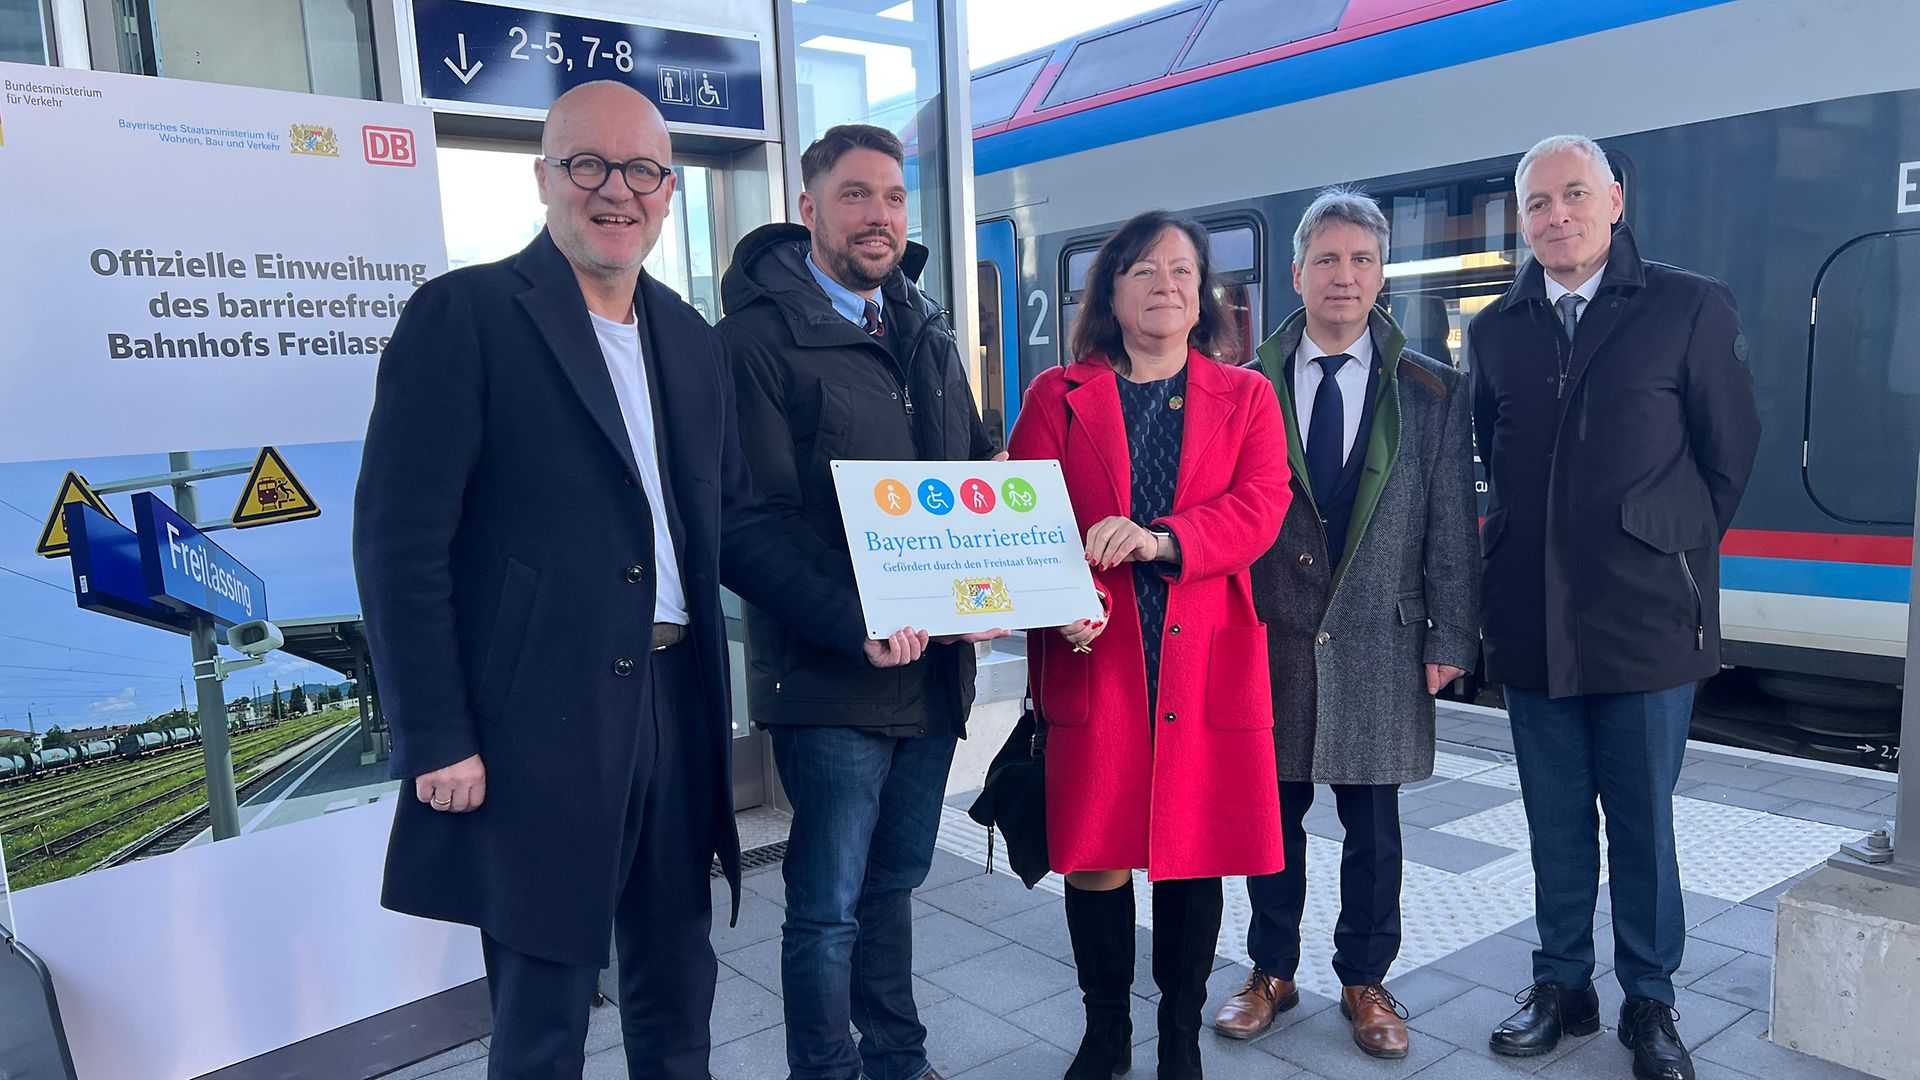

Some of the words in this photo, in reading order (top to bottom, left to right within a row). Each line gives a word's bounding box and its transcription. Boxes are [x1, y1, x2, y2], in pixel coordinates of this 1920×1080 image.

[508, 26, 574, 72] 2-5,
[582, 35, 634, 73] 7-8
[5, 80, 103, 98] Bundesministerium
[7, 93, 21, 104] für
[23, 95, 63, 107] Verkehr
[118, 119, 177, 132] Bayerisches
[180, 124, 264, 140] Staatsministerium
[267, 131, 279, 141] für
[159, 133, 202, 146] Wohnen,
[205, 137, 224, 147] Bau
[226, 139, 244, 149] und
[247, 141, 280, 151] Verkehr
[369, 131, 411, 161] DB
[90, 249, 247, 278] Offizielle
[255, 253, 428, 288] Einweihung
[149, 292, 210, 318] des
[1027, 289, 1050, 346] 2
[108, 332, 271, 359] Bahnhofs
[864, 531, 943, 557] Bayern
[946, 525, 1067, 549] barrierefrei
[166, 521, 252, 617] Freilassing
[883, 561, 931, 573] Gefördert
[933, 559, 962, 571] durch
[964, 557, 982, 569] den
[984, 557, 1025, 568] Freistaat
[1026, 555, 1062, 568] Bayern.
